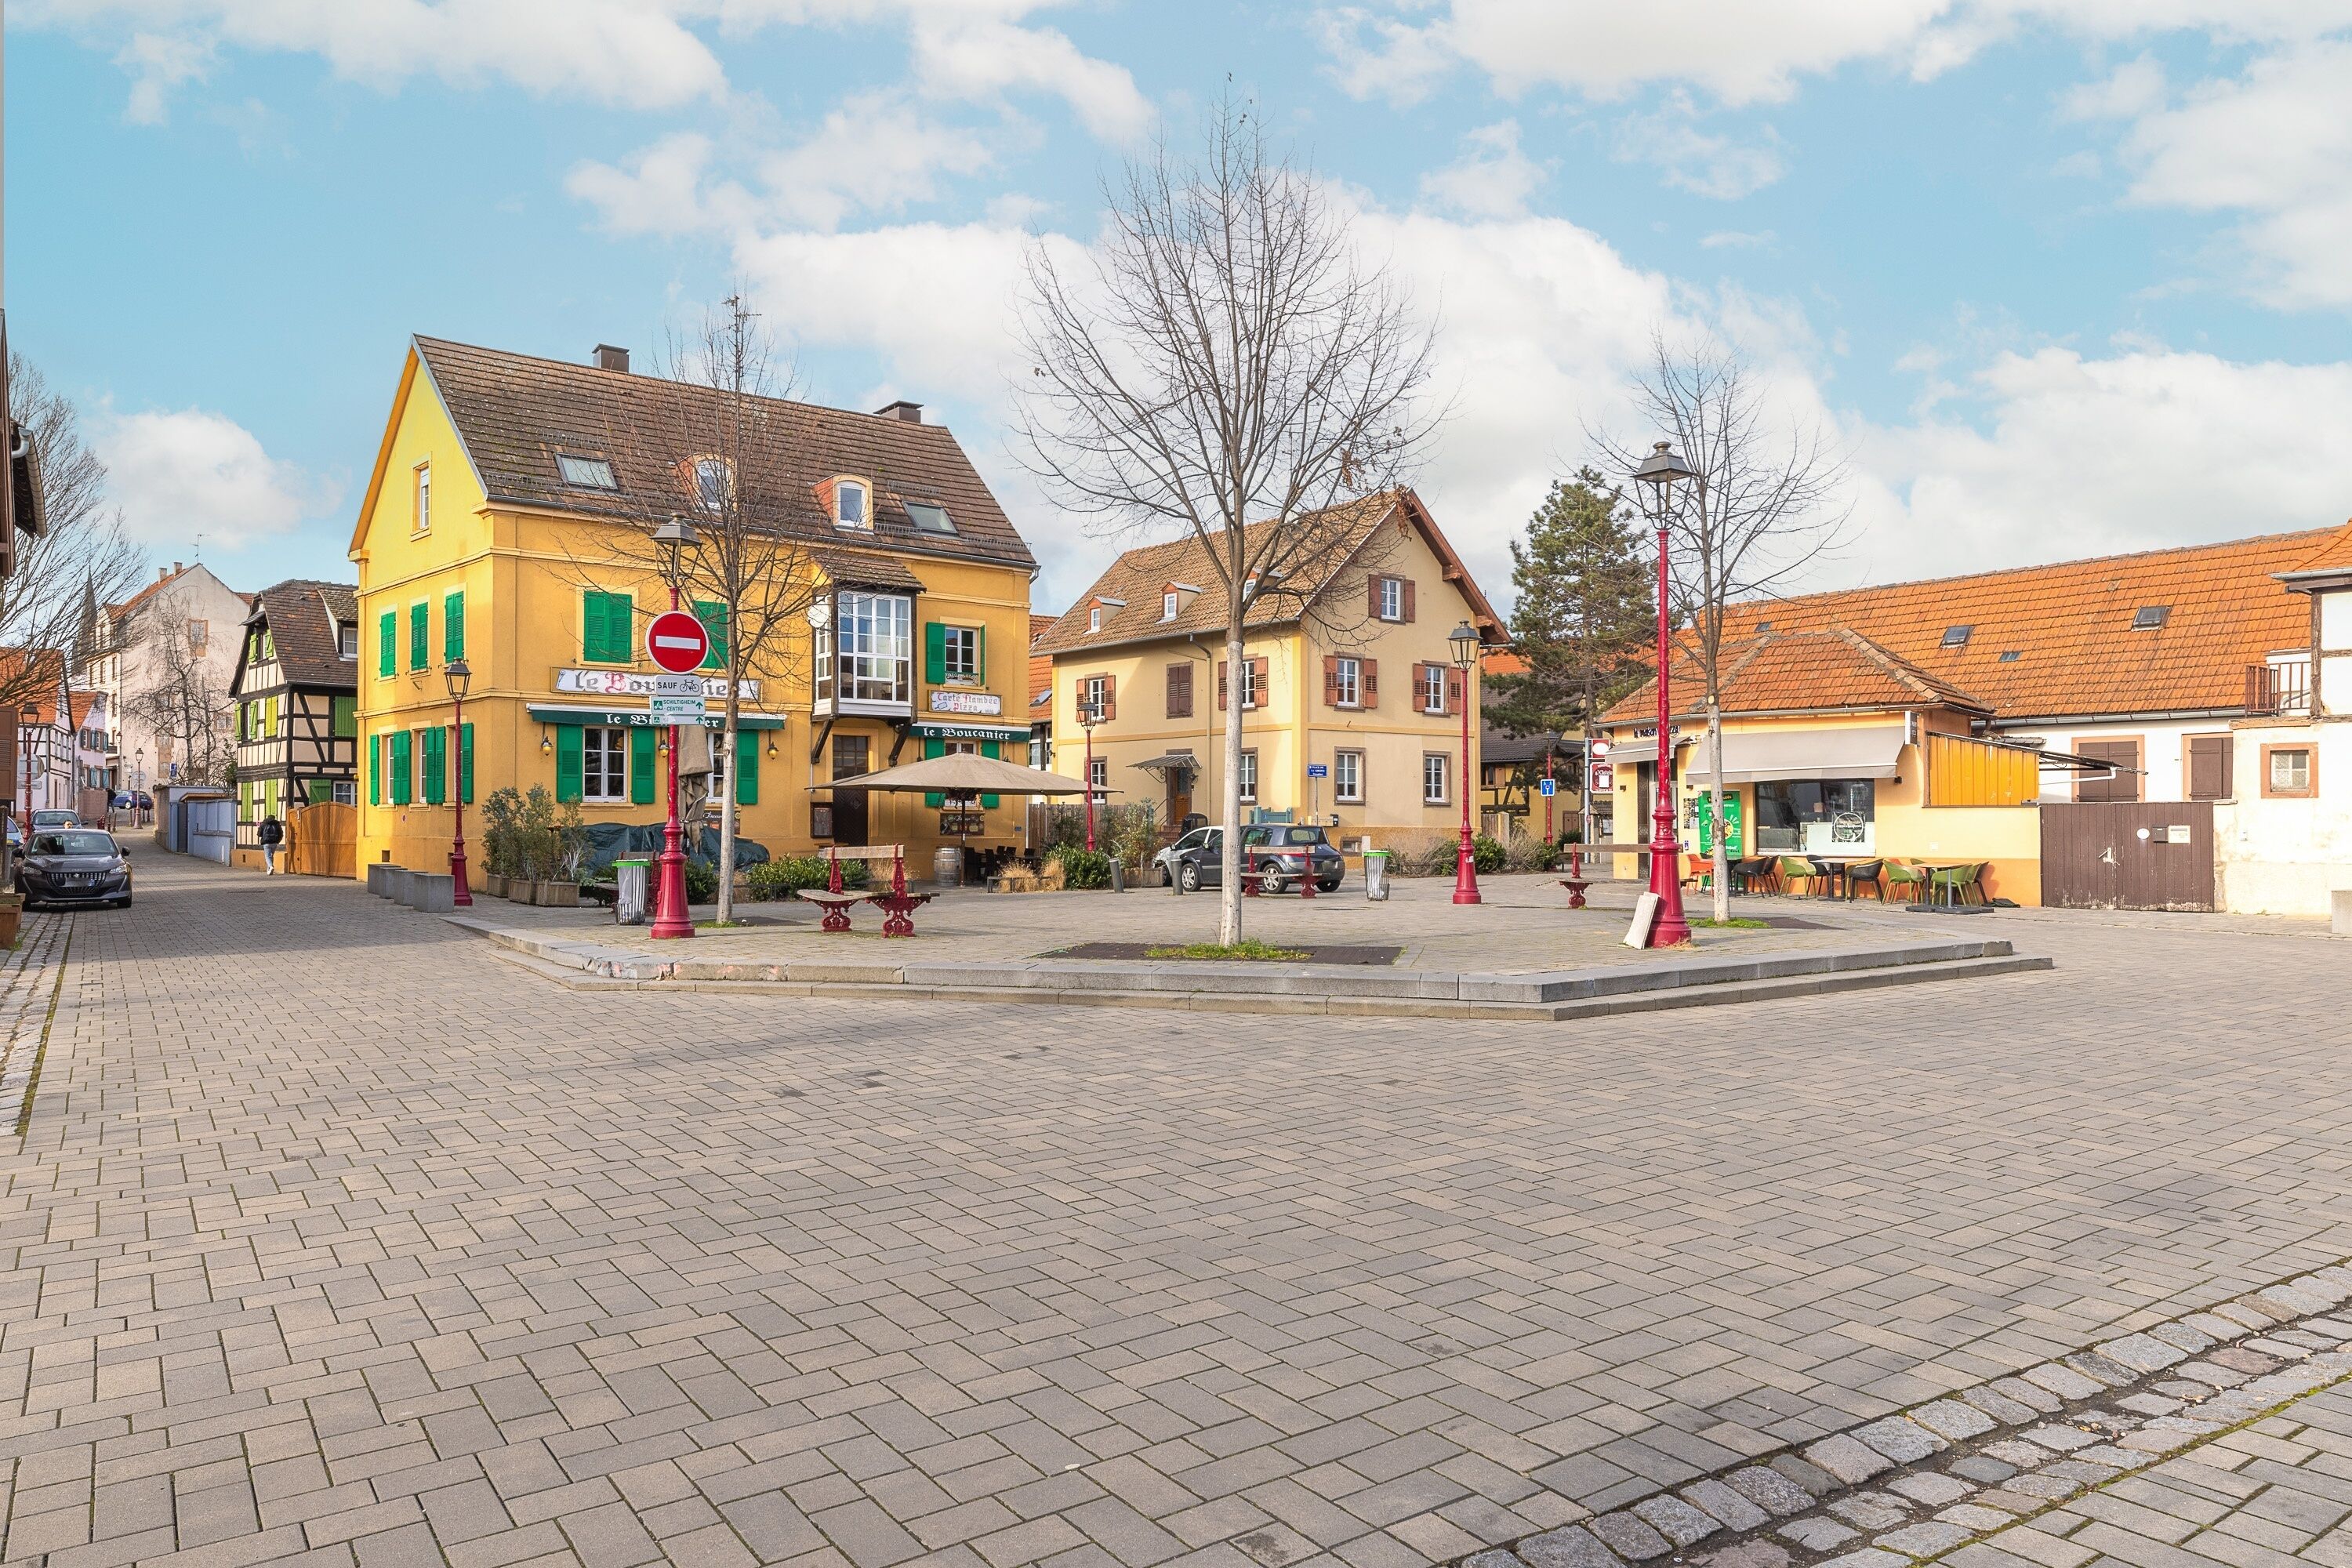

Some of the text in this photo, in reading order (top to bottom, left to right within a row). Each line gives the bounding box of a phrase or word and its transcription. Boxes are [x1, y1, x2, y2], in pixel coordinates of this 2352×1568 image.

[953, 702, 978, 712] Pizza
[605, 713, 622, 724] le
[924, 728, 1011, 740] le Boucanier
